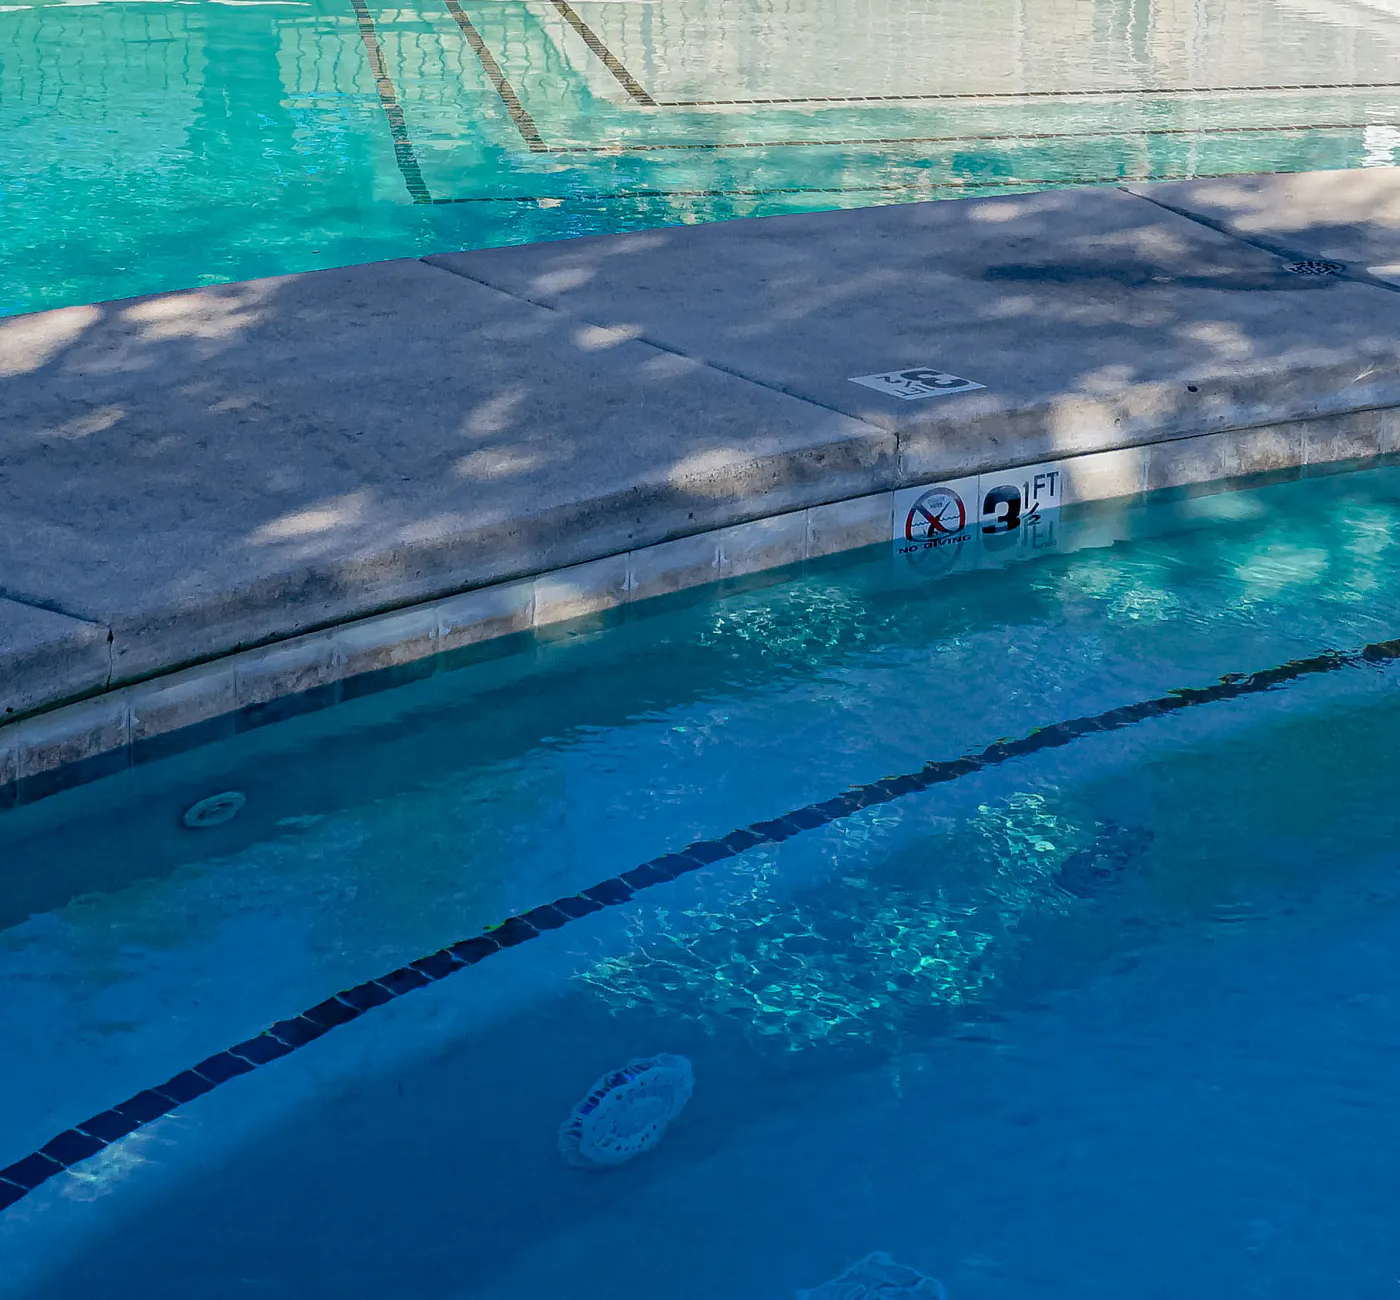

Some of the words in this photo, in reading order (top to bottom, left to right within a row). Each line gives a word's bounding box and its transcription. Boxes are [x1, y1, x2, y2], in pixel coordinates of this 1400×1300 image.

[981, 484, 1022, 534] 3
[1033, 471, 1060, 499] FT
[898, 545, 918, 555] NO
[923, 533, 972, 549] DIVING
